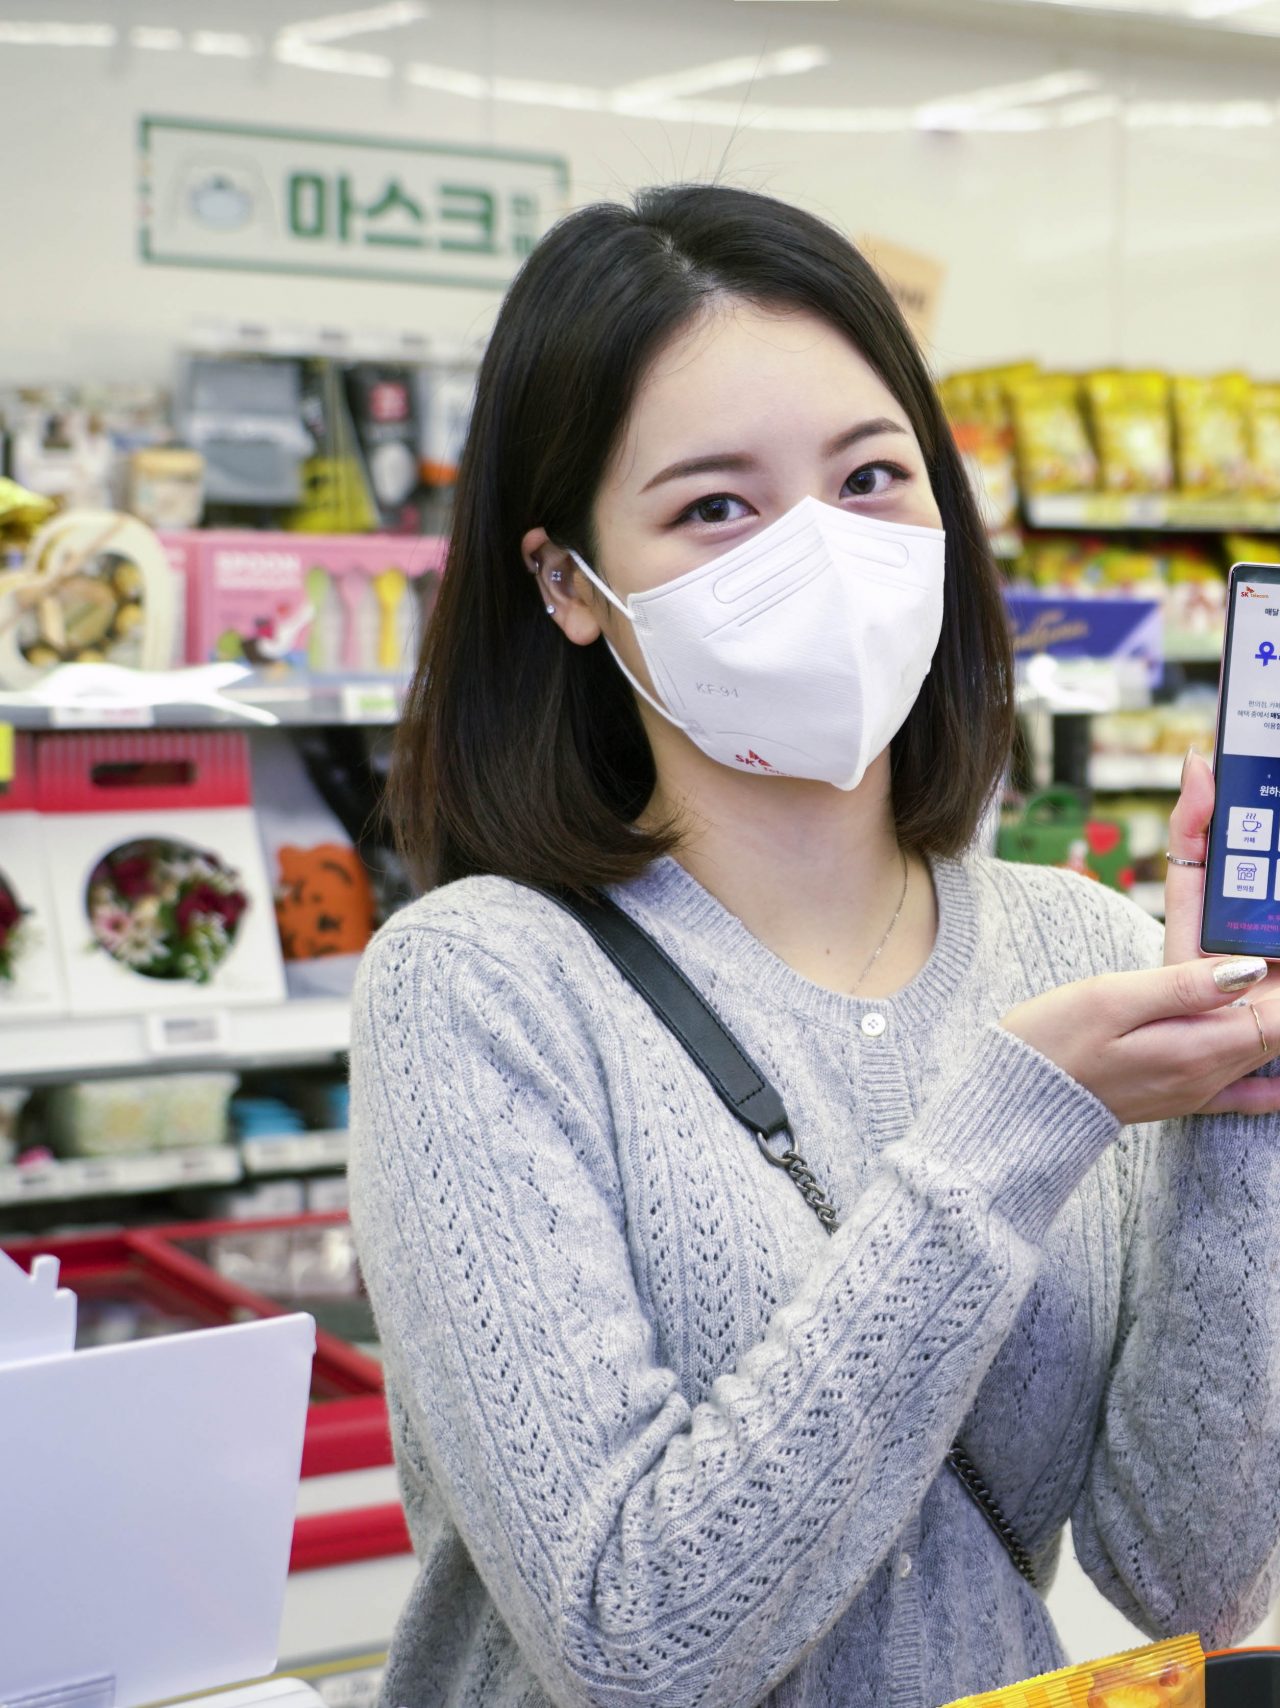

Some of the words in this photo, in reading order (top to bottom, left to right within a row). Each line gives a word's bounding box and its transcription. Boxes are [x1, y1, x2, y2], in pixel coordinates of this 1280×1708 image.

[288, 171, 497, 255] 마스크
[1264, 608, 1279, 617] 매달
[735, 754, 756, 768] SK
